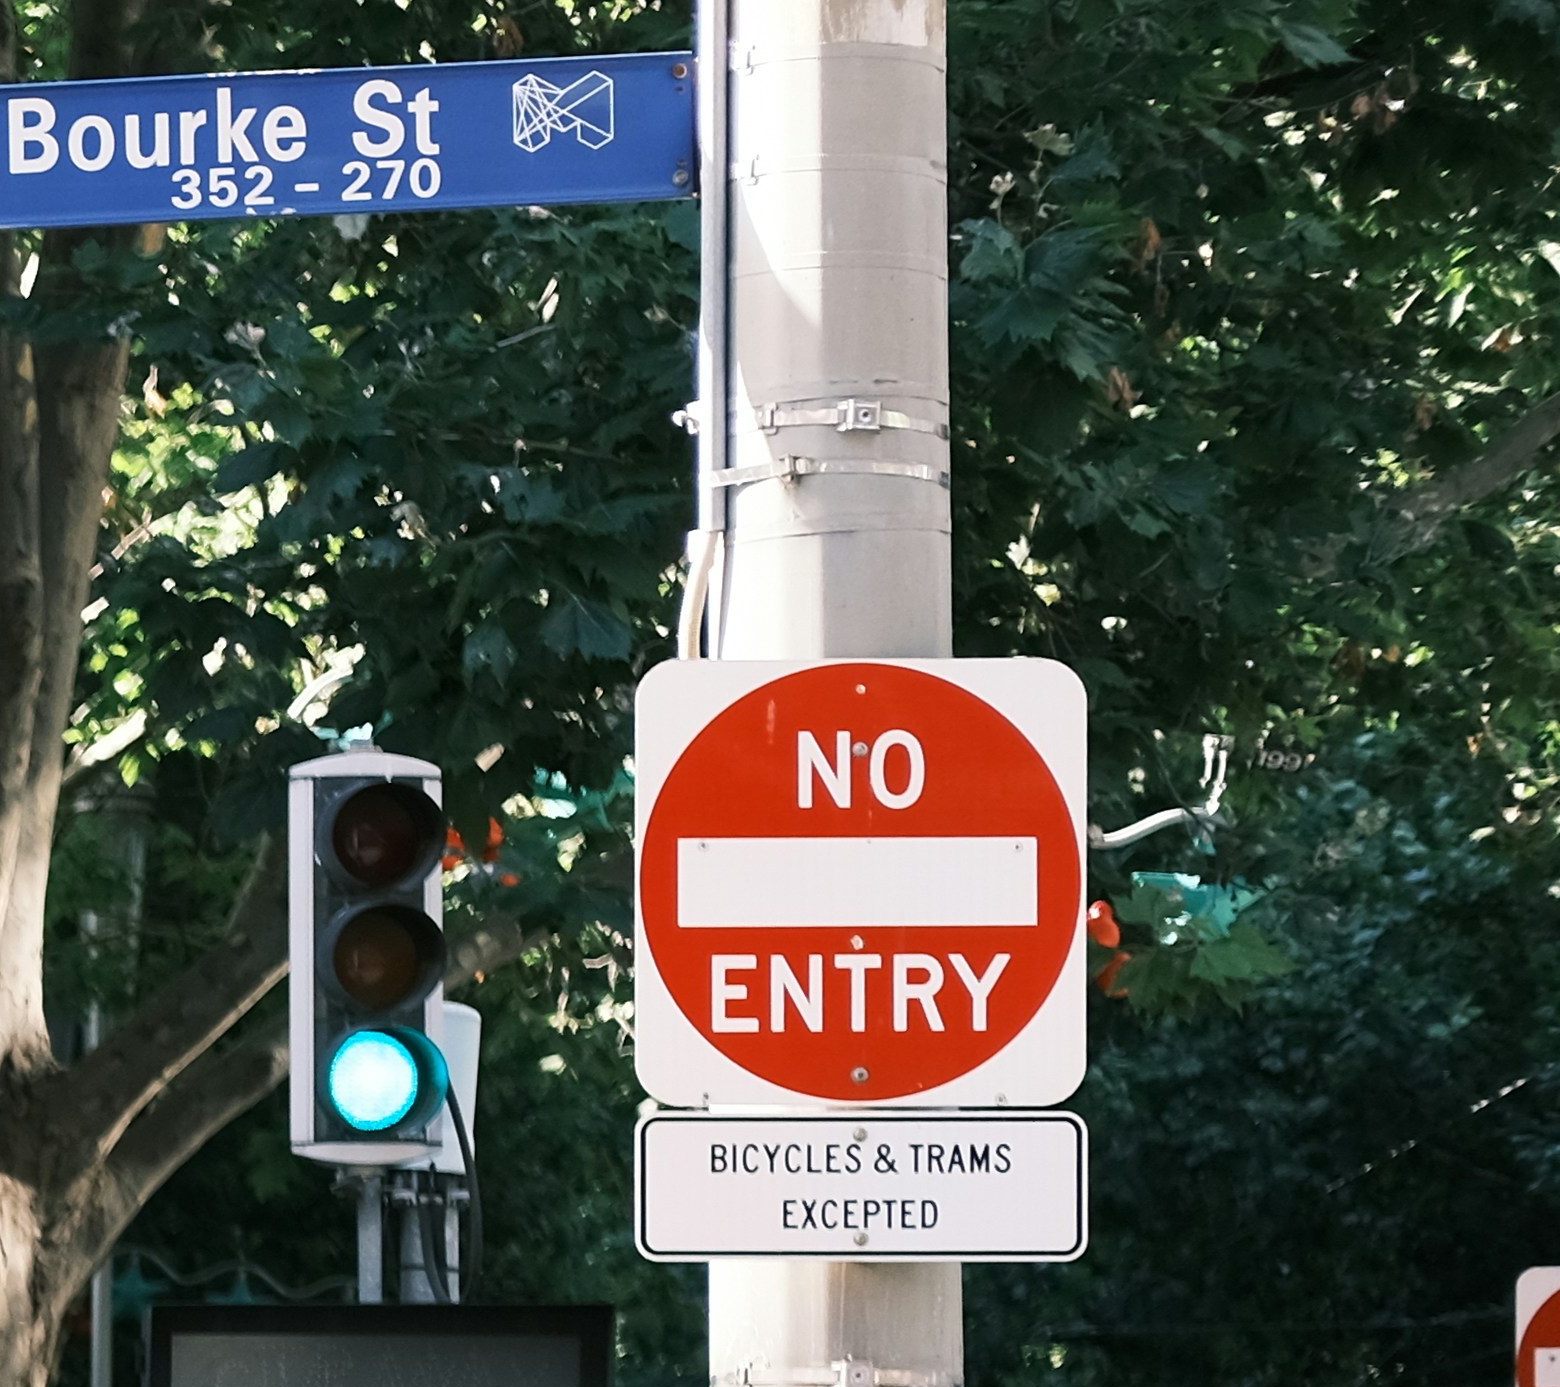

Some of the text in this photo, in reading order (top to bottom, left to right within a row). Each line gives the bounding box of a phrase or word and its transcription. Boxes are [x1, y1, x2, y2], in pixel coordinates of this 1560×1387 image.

[6, 79, 442, 176] Bourke St
[170, 165, 274, 210] 352
[341, 158, 442, 202] 270
[796, 729, 926, 810] NO
[710, 953, 1012, 1034] ENTRY
[709, 1142, 1013, 1174] BICYCLES & TRAMS
[781, 1199, 940, 1230] EXCEPTED
